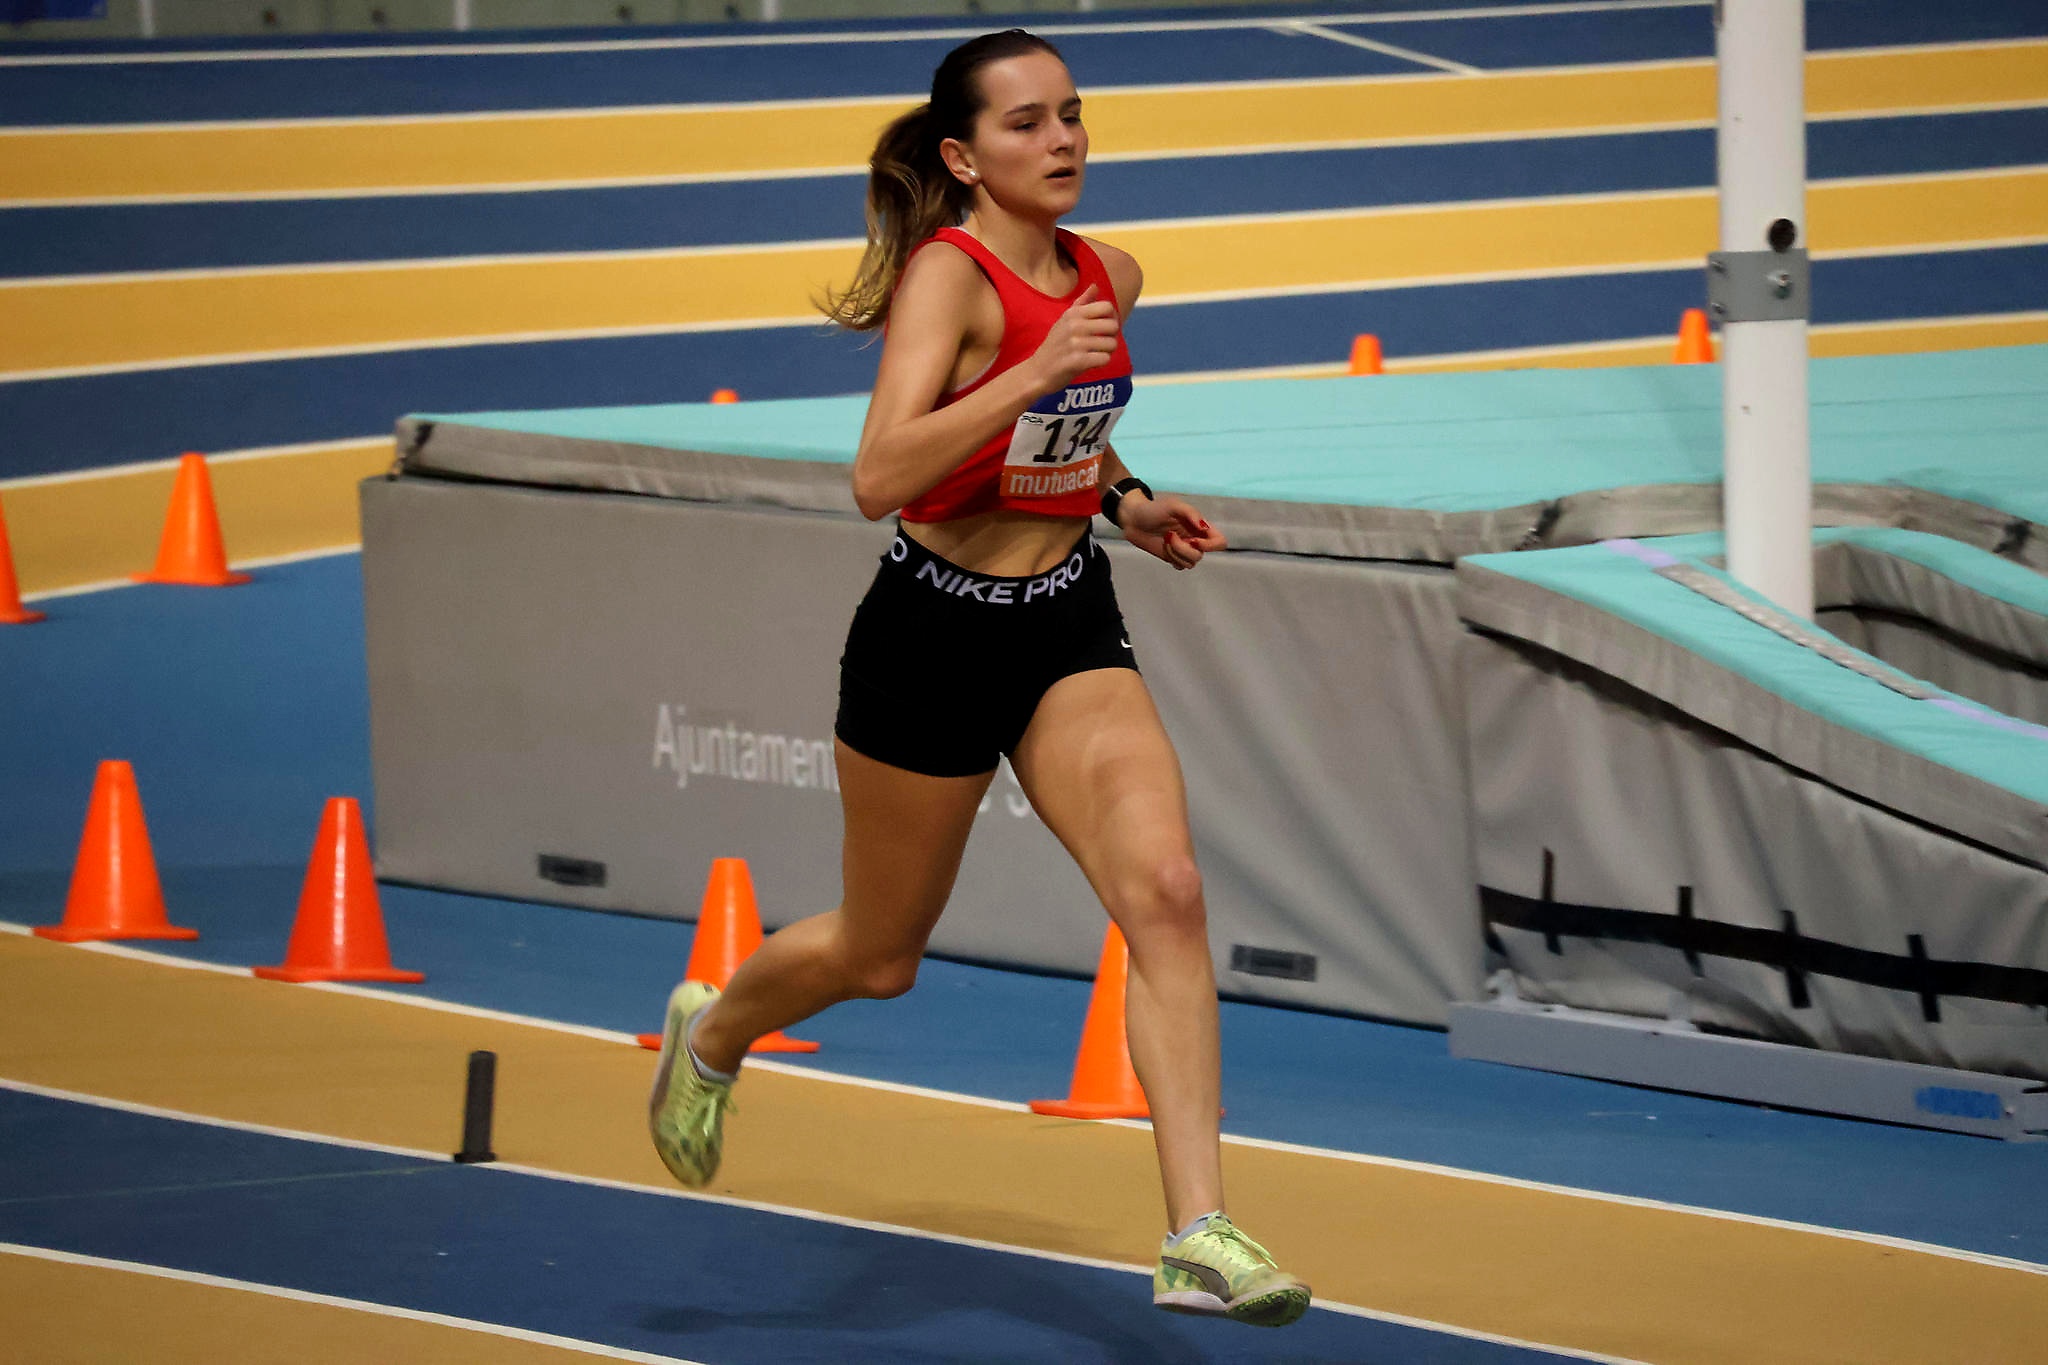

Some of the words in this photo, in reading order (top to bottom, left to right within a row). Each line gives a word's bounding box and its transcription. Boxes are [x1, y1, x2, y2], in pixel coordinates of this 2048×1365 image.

[1033, 412, 1111, 463] 134
[915, 560, 1020, 604] NIKE
[1024, 553, 1083, 603] PRO
[652, 703, 840, 793] Ajuntamen
